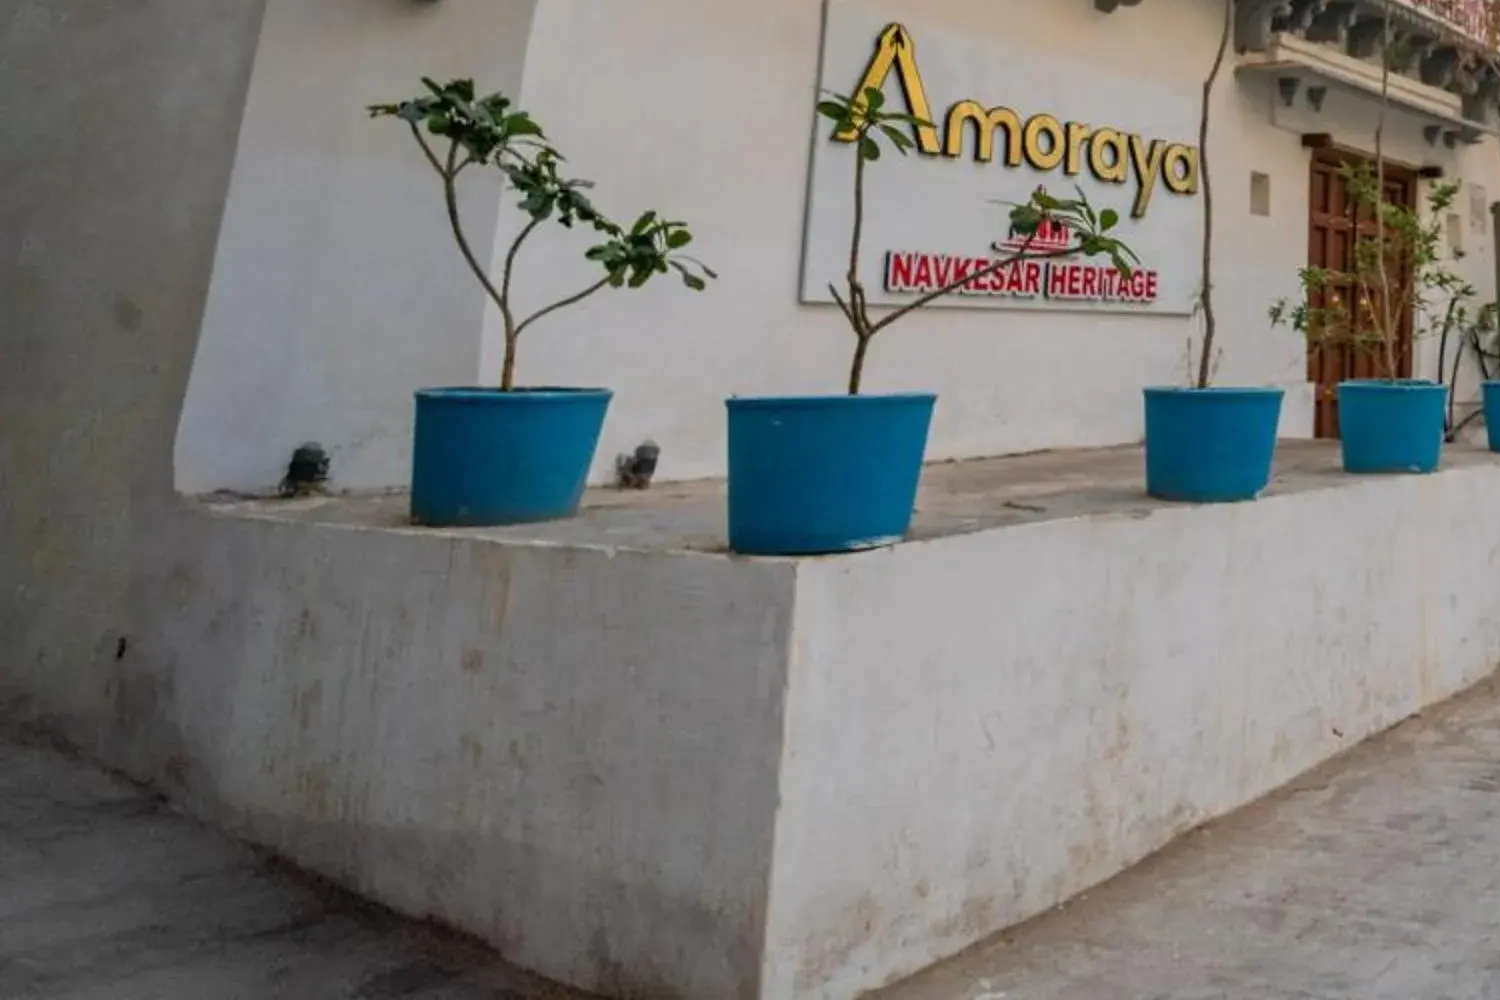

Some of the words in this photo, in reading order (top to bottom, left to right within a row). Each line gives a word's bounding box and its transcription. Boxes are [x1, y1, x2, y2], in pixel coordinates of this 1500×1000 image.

[830, 22, 1198, 219] Amoraya
[889, 252, 1041, 293] NAVKESAR
[1049, 263, 1158, 299] HERITAGE
